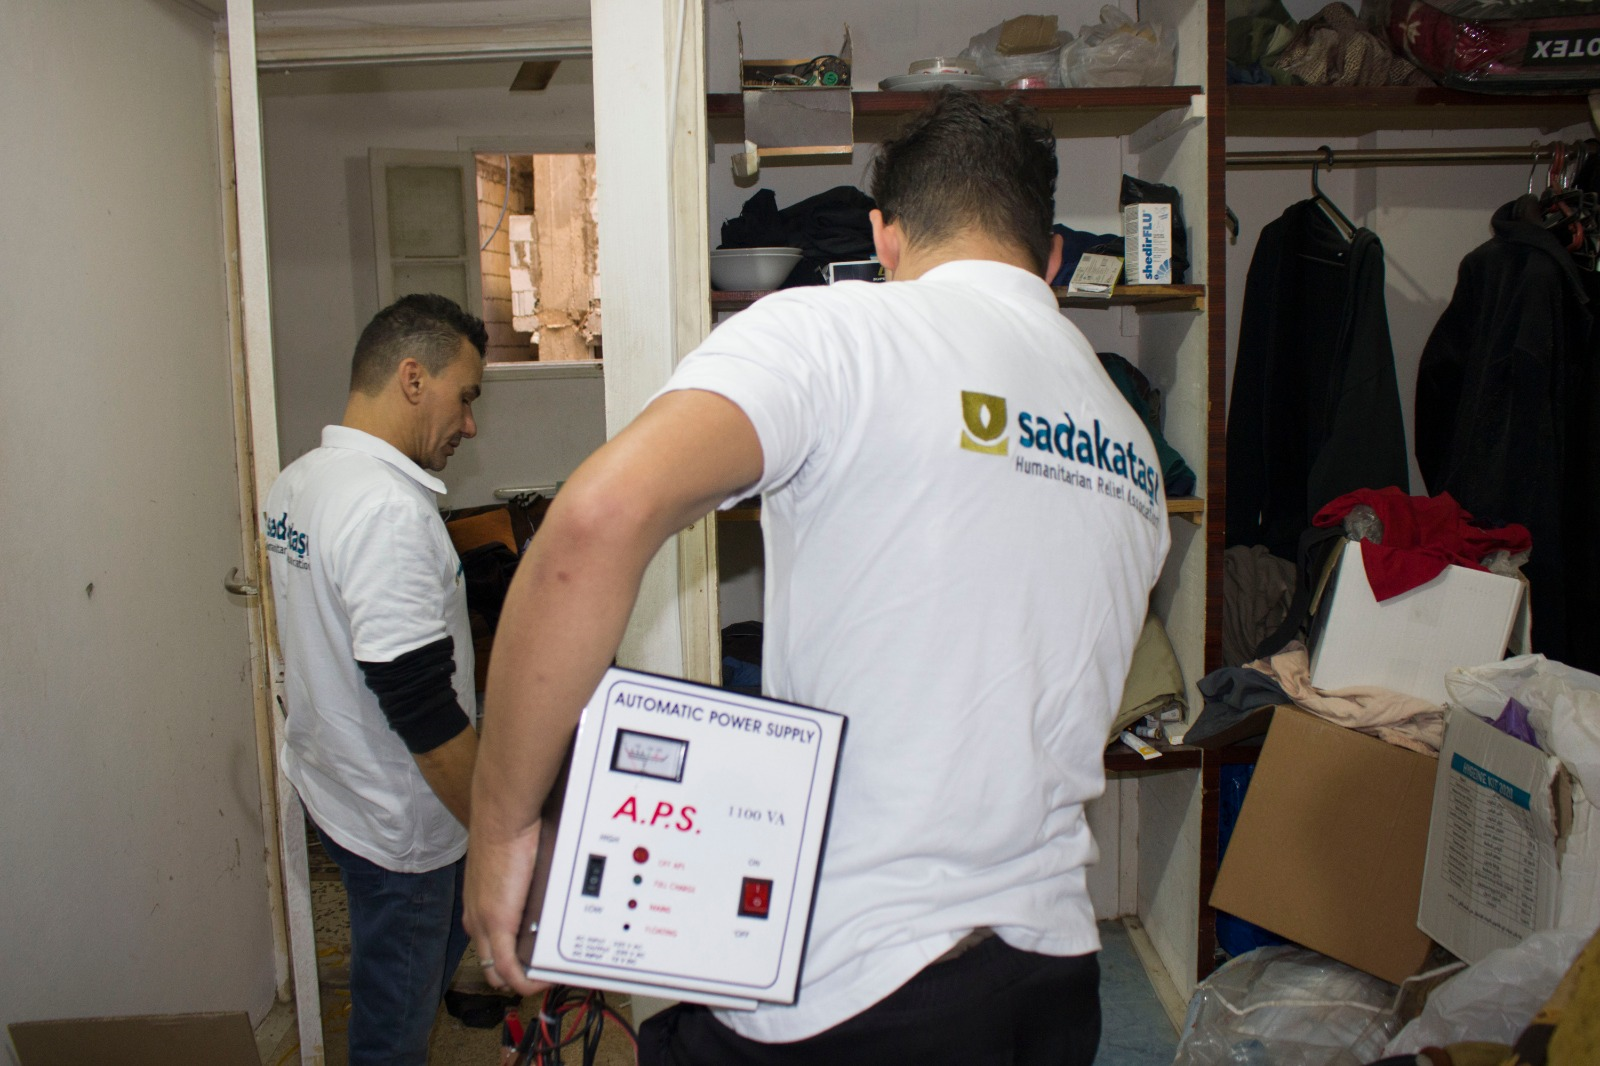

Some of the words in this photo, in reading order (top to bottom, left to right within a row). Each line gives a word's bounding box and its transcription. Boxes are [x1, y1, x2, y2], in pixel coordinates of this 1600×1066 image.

[1142, 213, 1153, 280] shedirFLU
[1015, 455, 1093, 491] Humanitarian
[614, 691, 705, 722] AUTOMATIC
[708, 710, 761, 733] POWER
[766, 723, 816, 745] SUPPLY
[612, 796, 702, 835] A.P.S.
[728, 805, 763, 821] 1100
[767, 810, 786, 826] VA
[748, 858, 761, 867] ON
[733, 929, 750, 939] OFF
